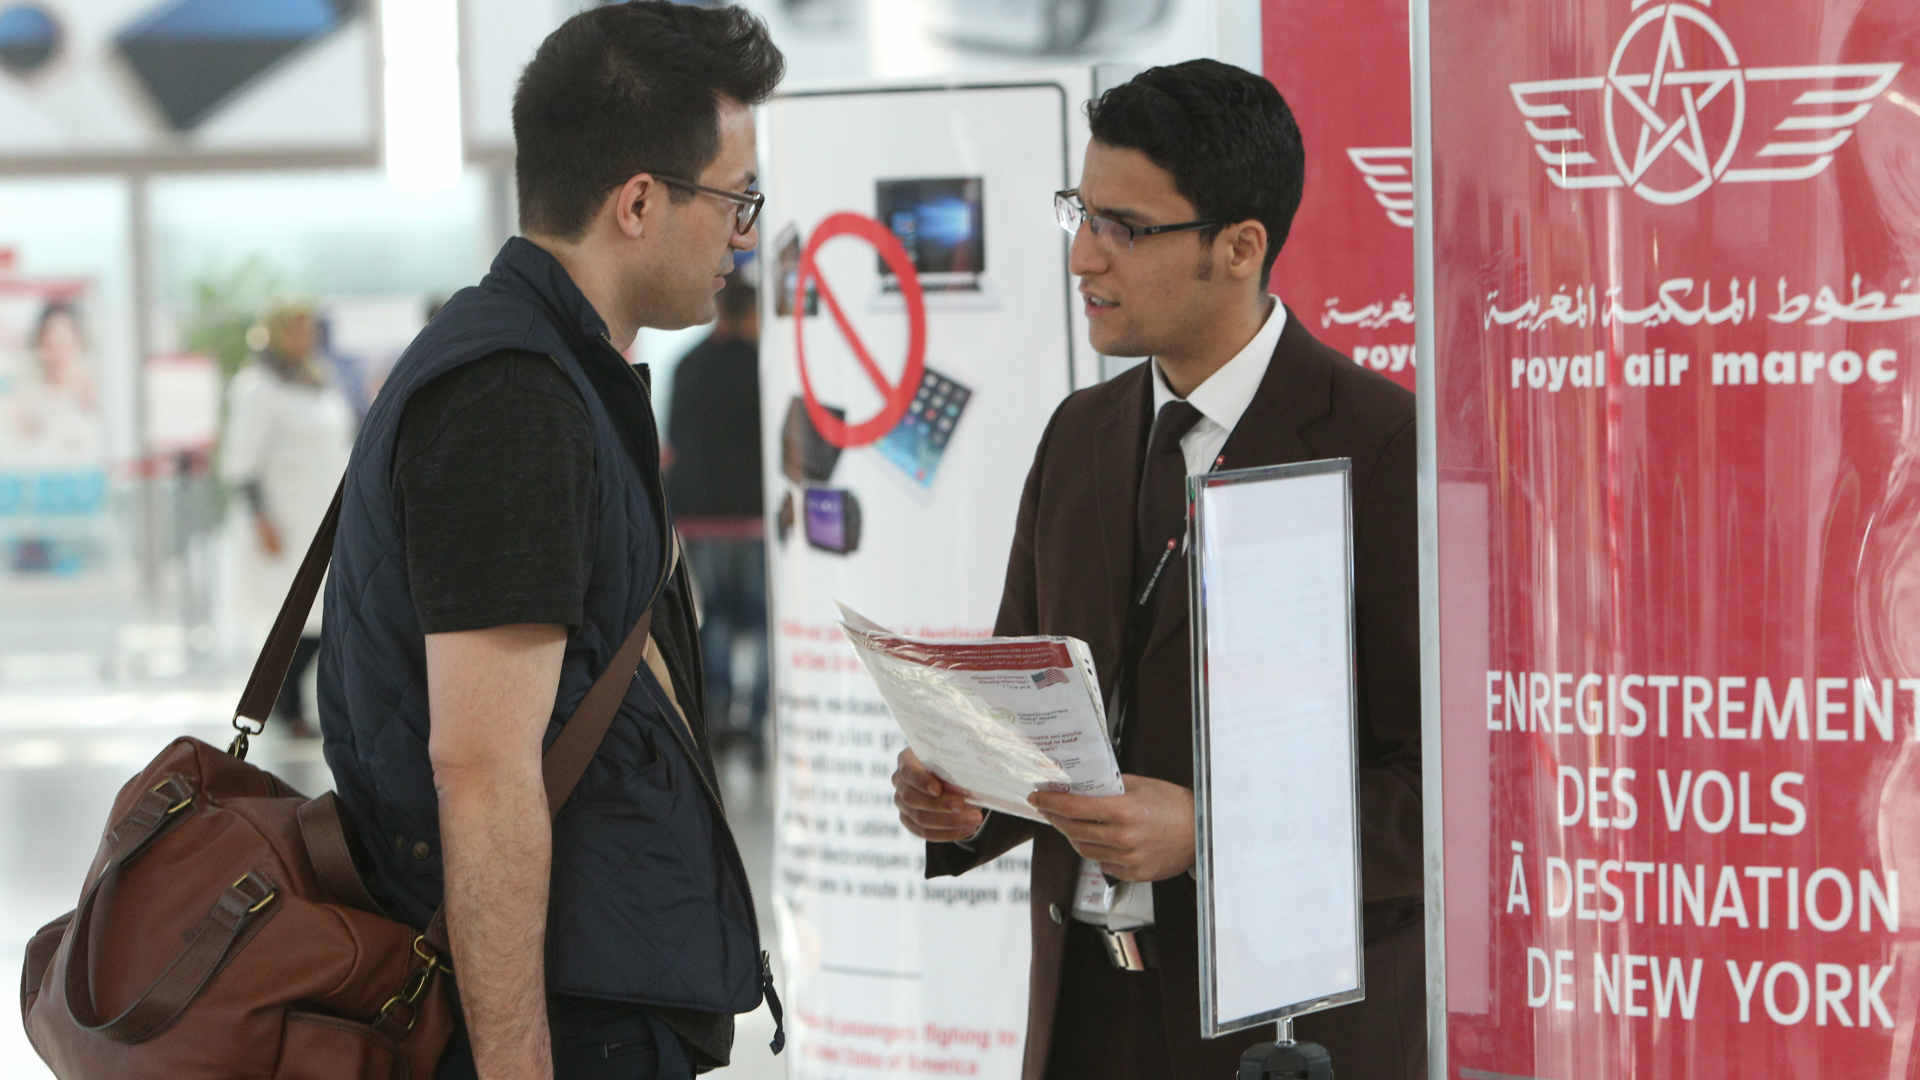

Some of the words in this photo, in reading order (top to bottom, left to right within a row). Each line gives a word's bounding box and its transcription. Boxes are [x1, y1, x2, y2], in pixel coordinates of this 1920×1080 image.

[1353, 344, 1416, 372] roy
[1511, 350, 1605, 392] royal
[1624, 348, 1690, 387] air
[1712, 349, 1898, 384] maroc
[1486, 671, 1920, 742] ENREGISTREMENT
[1557, 765, 1639, 831] DES
[1657, 769, 1807, 836] VOLS
[1506, 840, 1531, 917] À
[1546, 857, 1900, 934] DESTINATION
[1527, 947, 1576, 1012] DE
[1593, 953, 1703, 1021] NEW
[1726, 960, 1896, 1030] YORK
